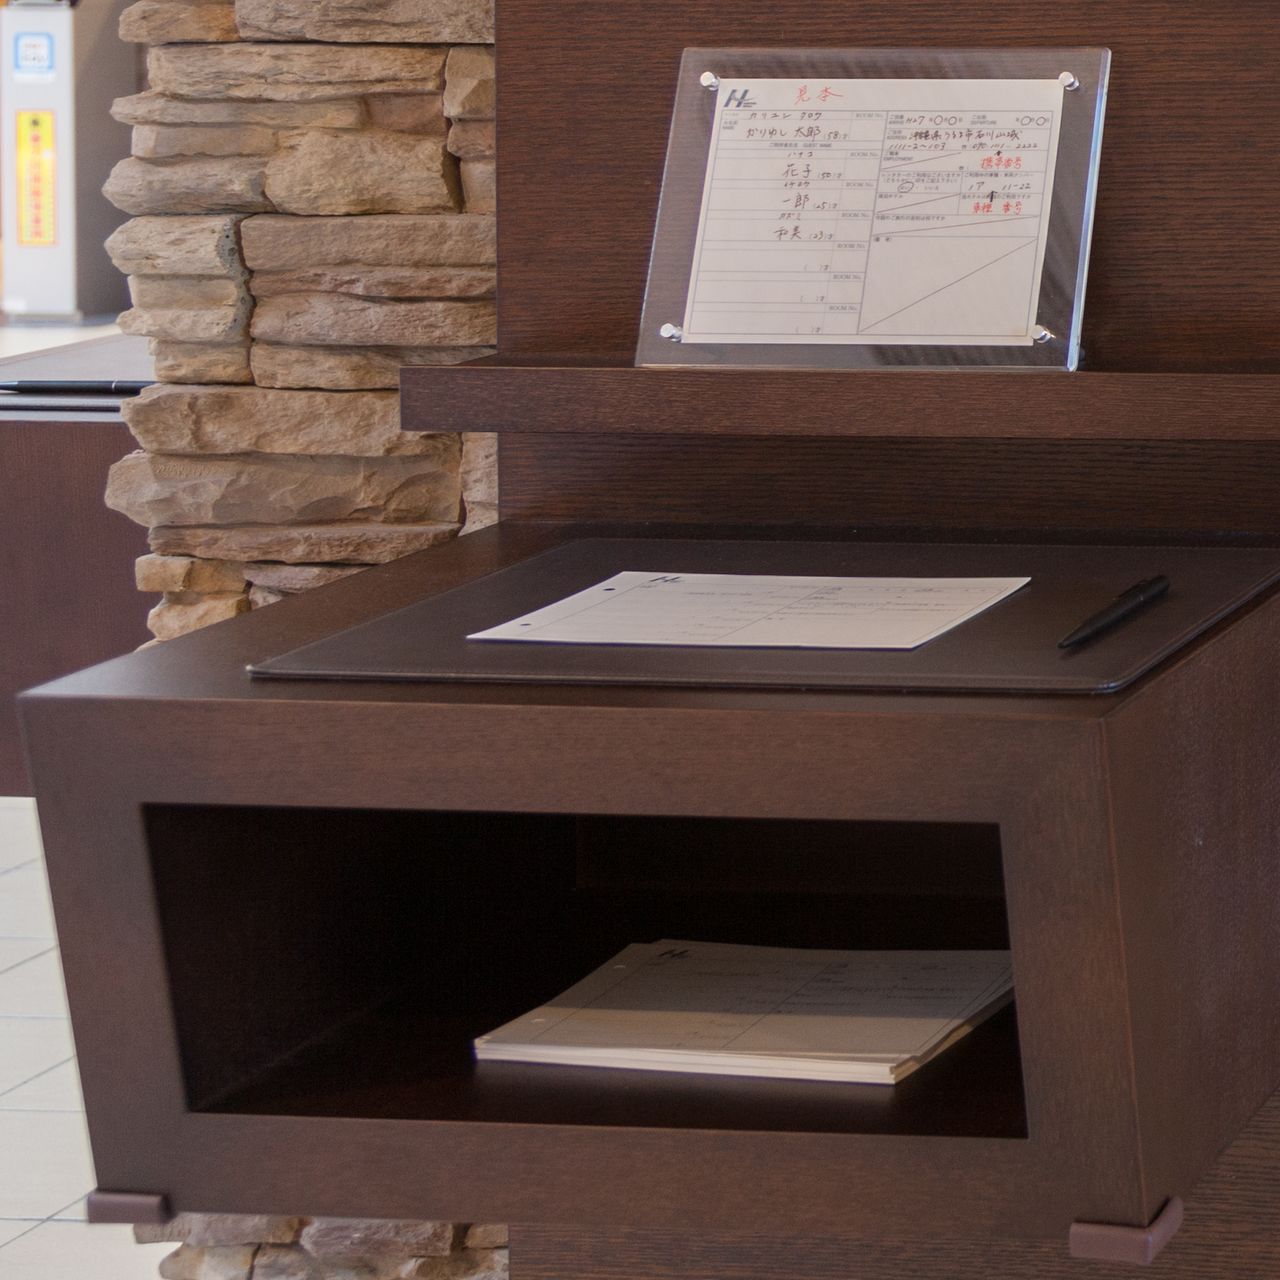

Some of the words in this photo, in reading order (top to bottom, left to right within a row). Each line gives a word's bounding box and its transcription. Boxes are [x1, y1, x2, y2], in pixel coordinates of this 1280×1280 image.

[794, 84, 844, 106] 見本
[794, 126, 821, 143] 太郎
[782, 163, 812, 179] 花子
[781, 192, 811, 210] 一郎
